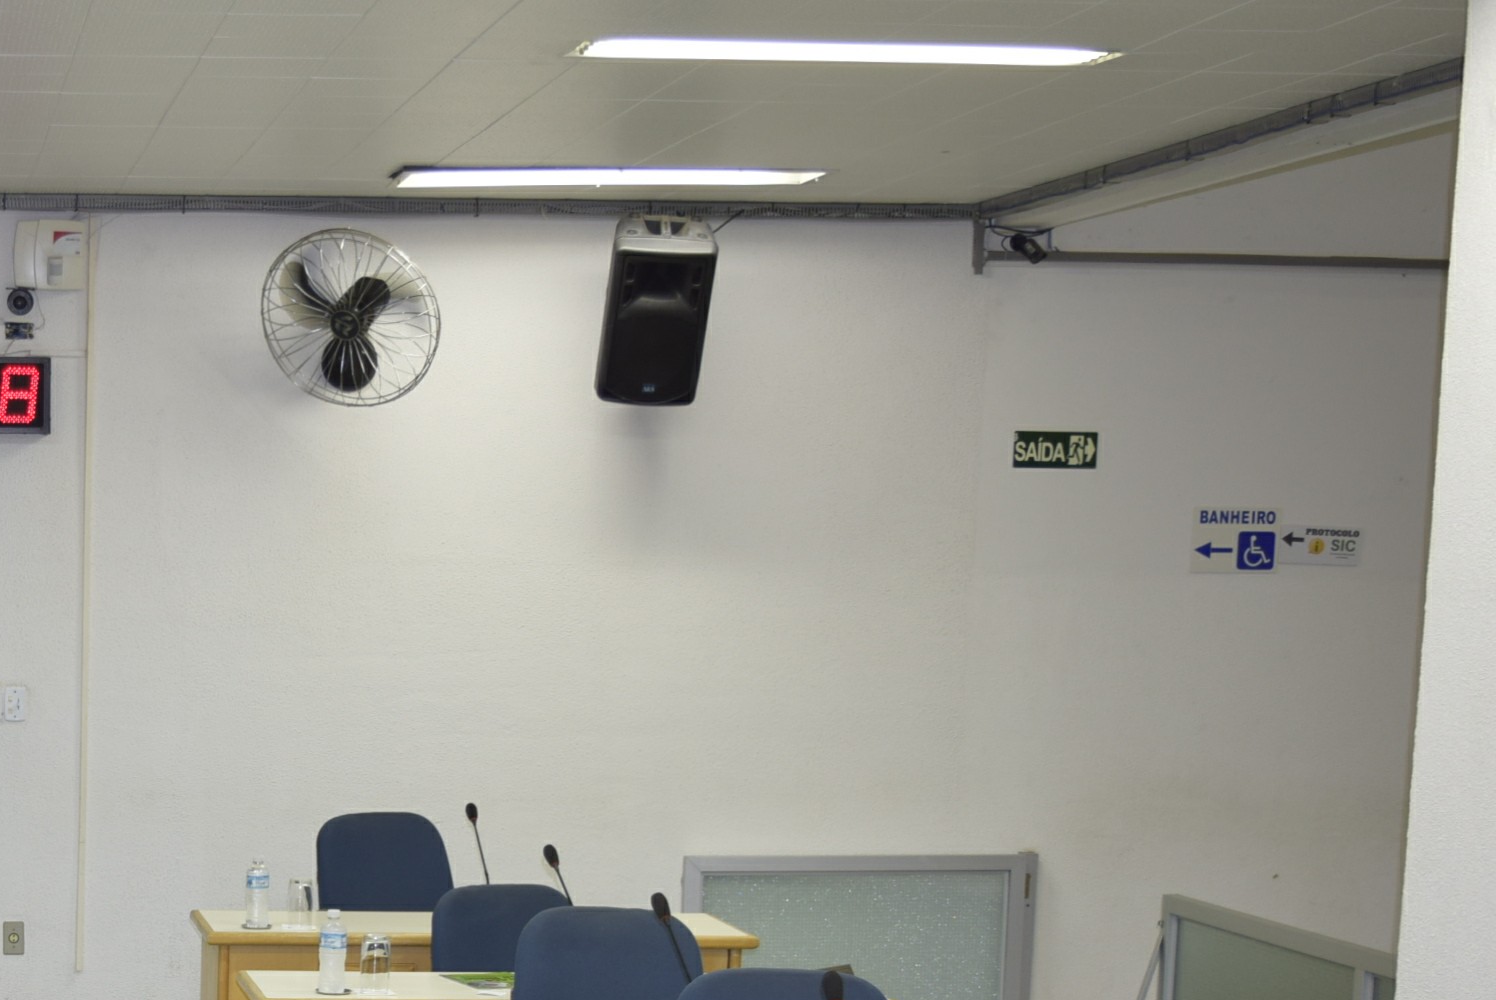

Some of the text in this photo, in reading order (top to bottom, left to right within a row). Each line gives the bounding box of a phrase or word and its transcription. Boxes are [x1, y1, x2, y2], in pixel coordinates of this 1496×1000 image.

[1014, 439, 1066, 462] SAÍDA
[1199, 510, 1276, 525] BANHEIRO
[1306, 528, 1360, 538] PROTOCOLO
[1330, 539, 1356, 553] SIC
